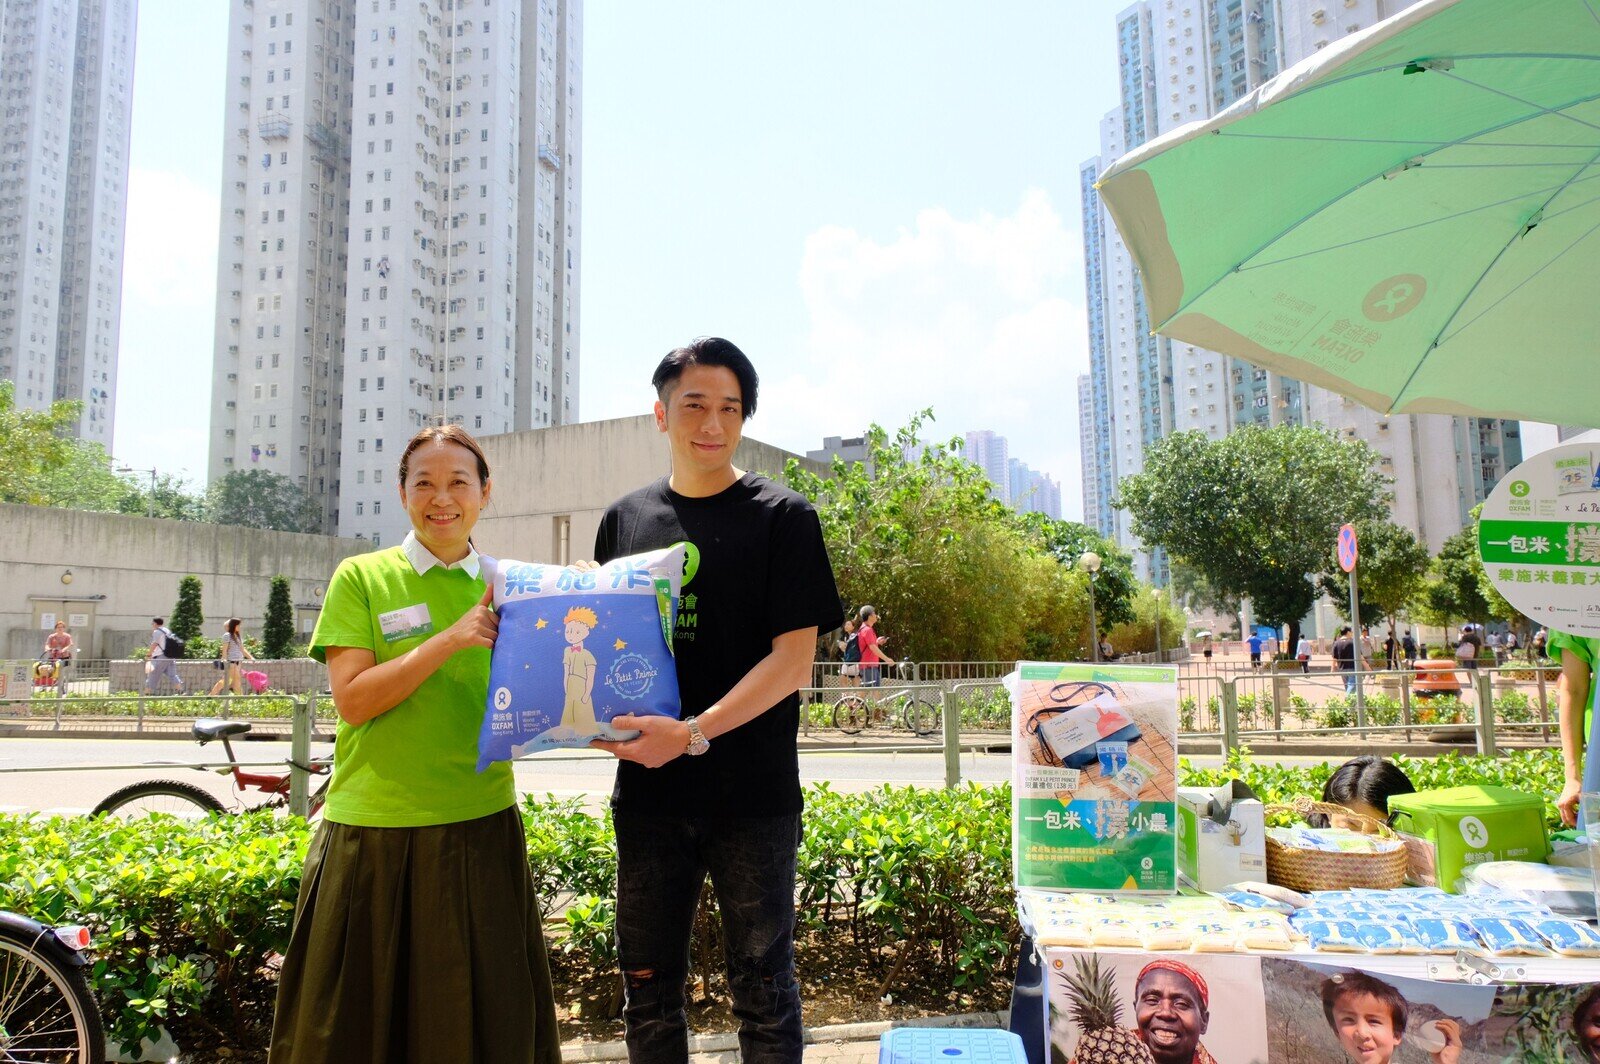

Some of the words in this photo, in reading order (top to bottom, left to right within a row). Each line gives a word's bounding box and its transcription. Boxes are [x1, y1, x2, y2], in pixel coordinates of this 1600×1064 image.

[1578, 503, 1588, 512] Le
[505, 559, 651, 597] 樂施米
[676, 613, 697, 628] AM
[674, 631, 695, 641] Kong
[604, 674, 613, 686] Le
[615, 672, 632, 683] Petit
[634, 668, 658, 680] Prince
[491, 722, 513, 730] OXFAM
